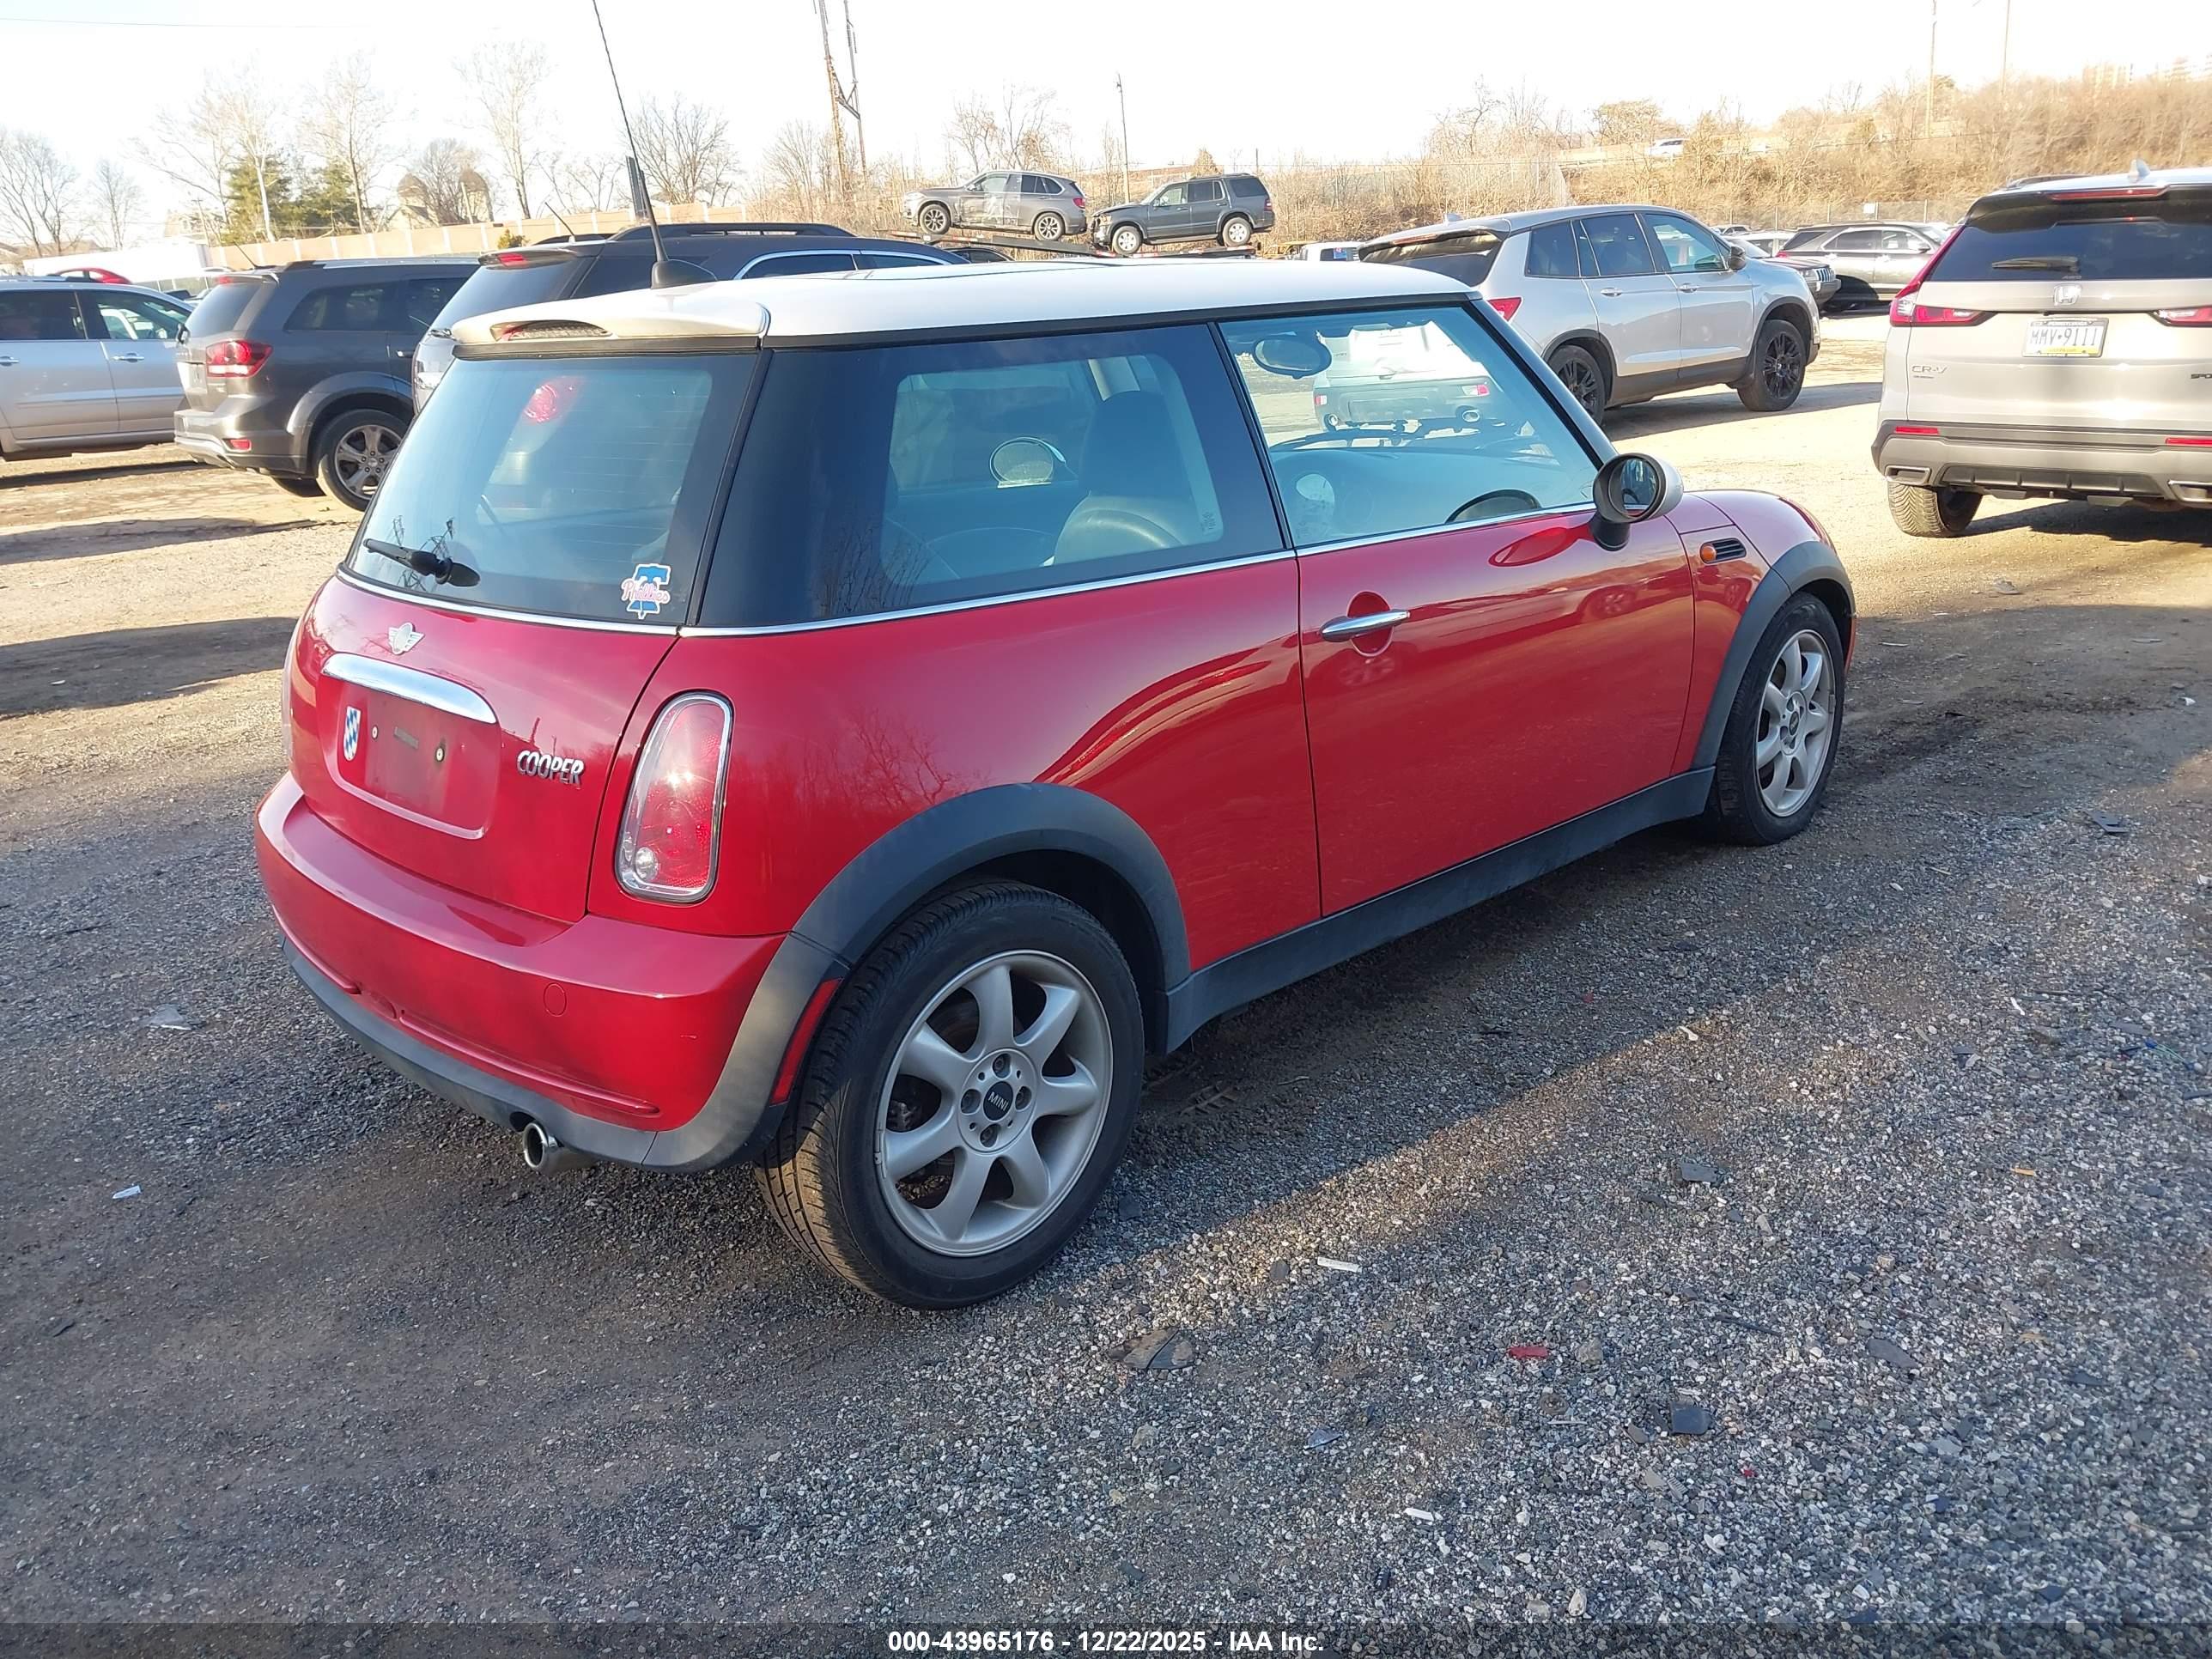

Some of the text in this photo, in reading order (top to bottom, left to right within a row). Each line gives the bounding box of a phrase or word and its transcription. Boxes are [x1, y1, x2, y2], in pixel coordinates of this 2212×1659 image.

[1911, 364, 1948, 374] CR-V
[622, 580, 669, 603] Phillies
[517, 750, 585, 785] COOPER
[988, 1091, 1009, 1111] MINI
